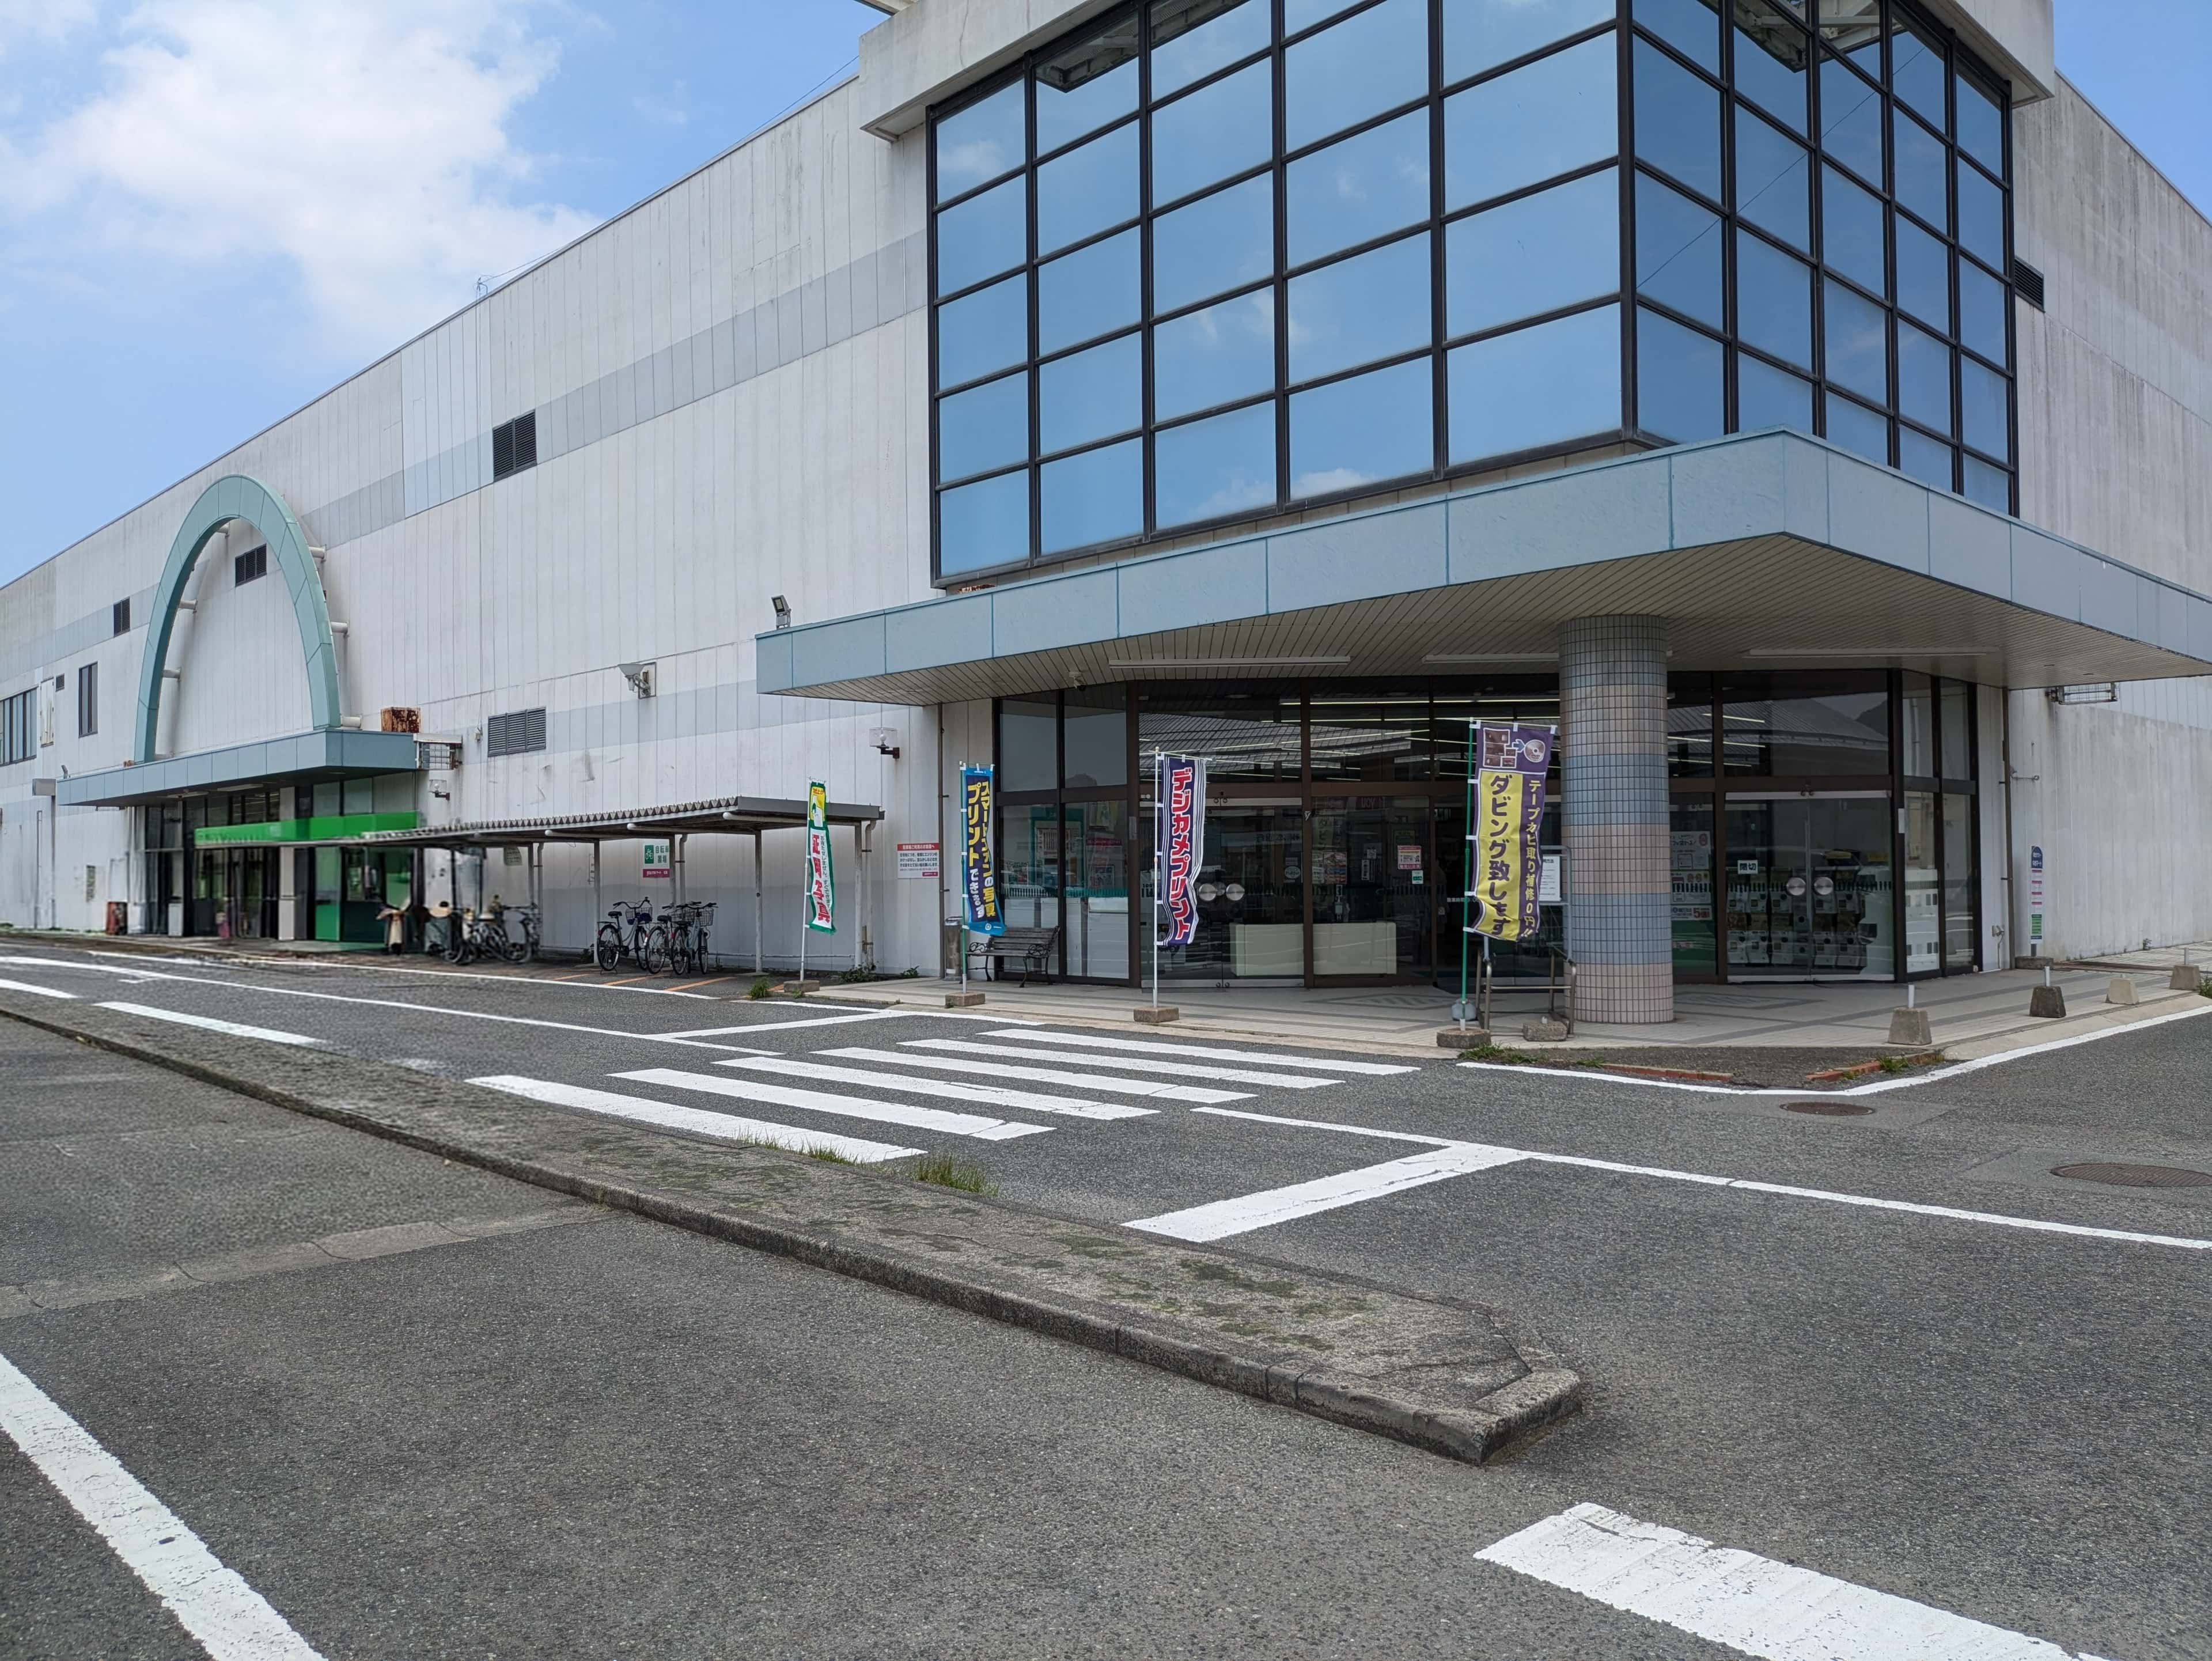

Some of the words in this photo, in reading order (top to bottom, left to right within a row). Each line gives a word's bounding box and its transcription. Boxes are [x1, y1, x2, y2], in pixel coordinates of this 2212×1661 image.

[1170, 768, 1192, 940] デジカメプリント
[1488, 774, 1512, 934] ダビング致します
